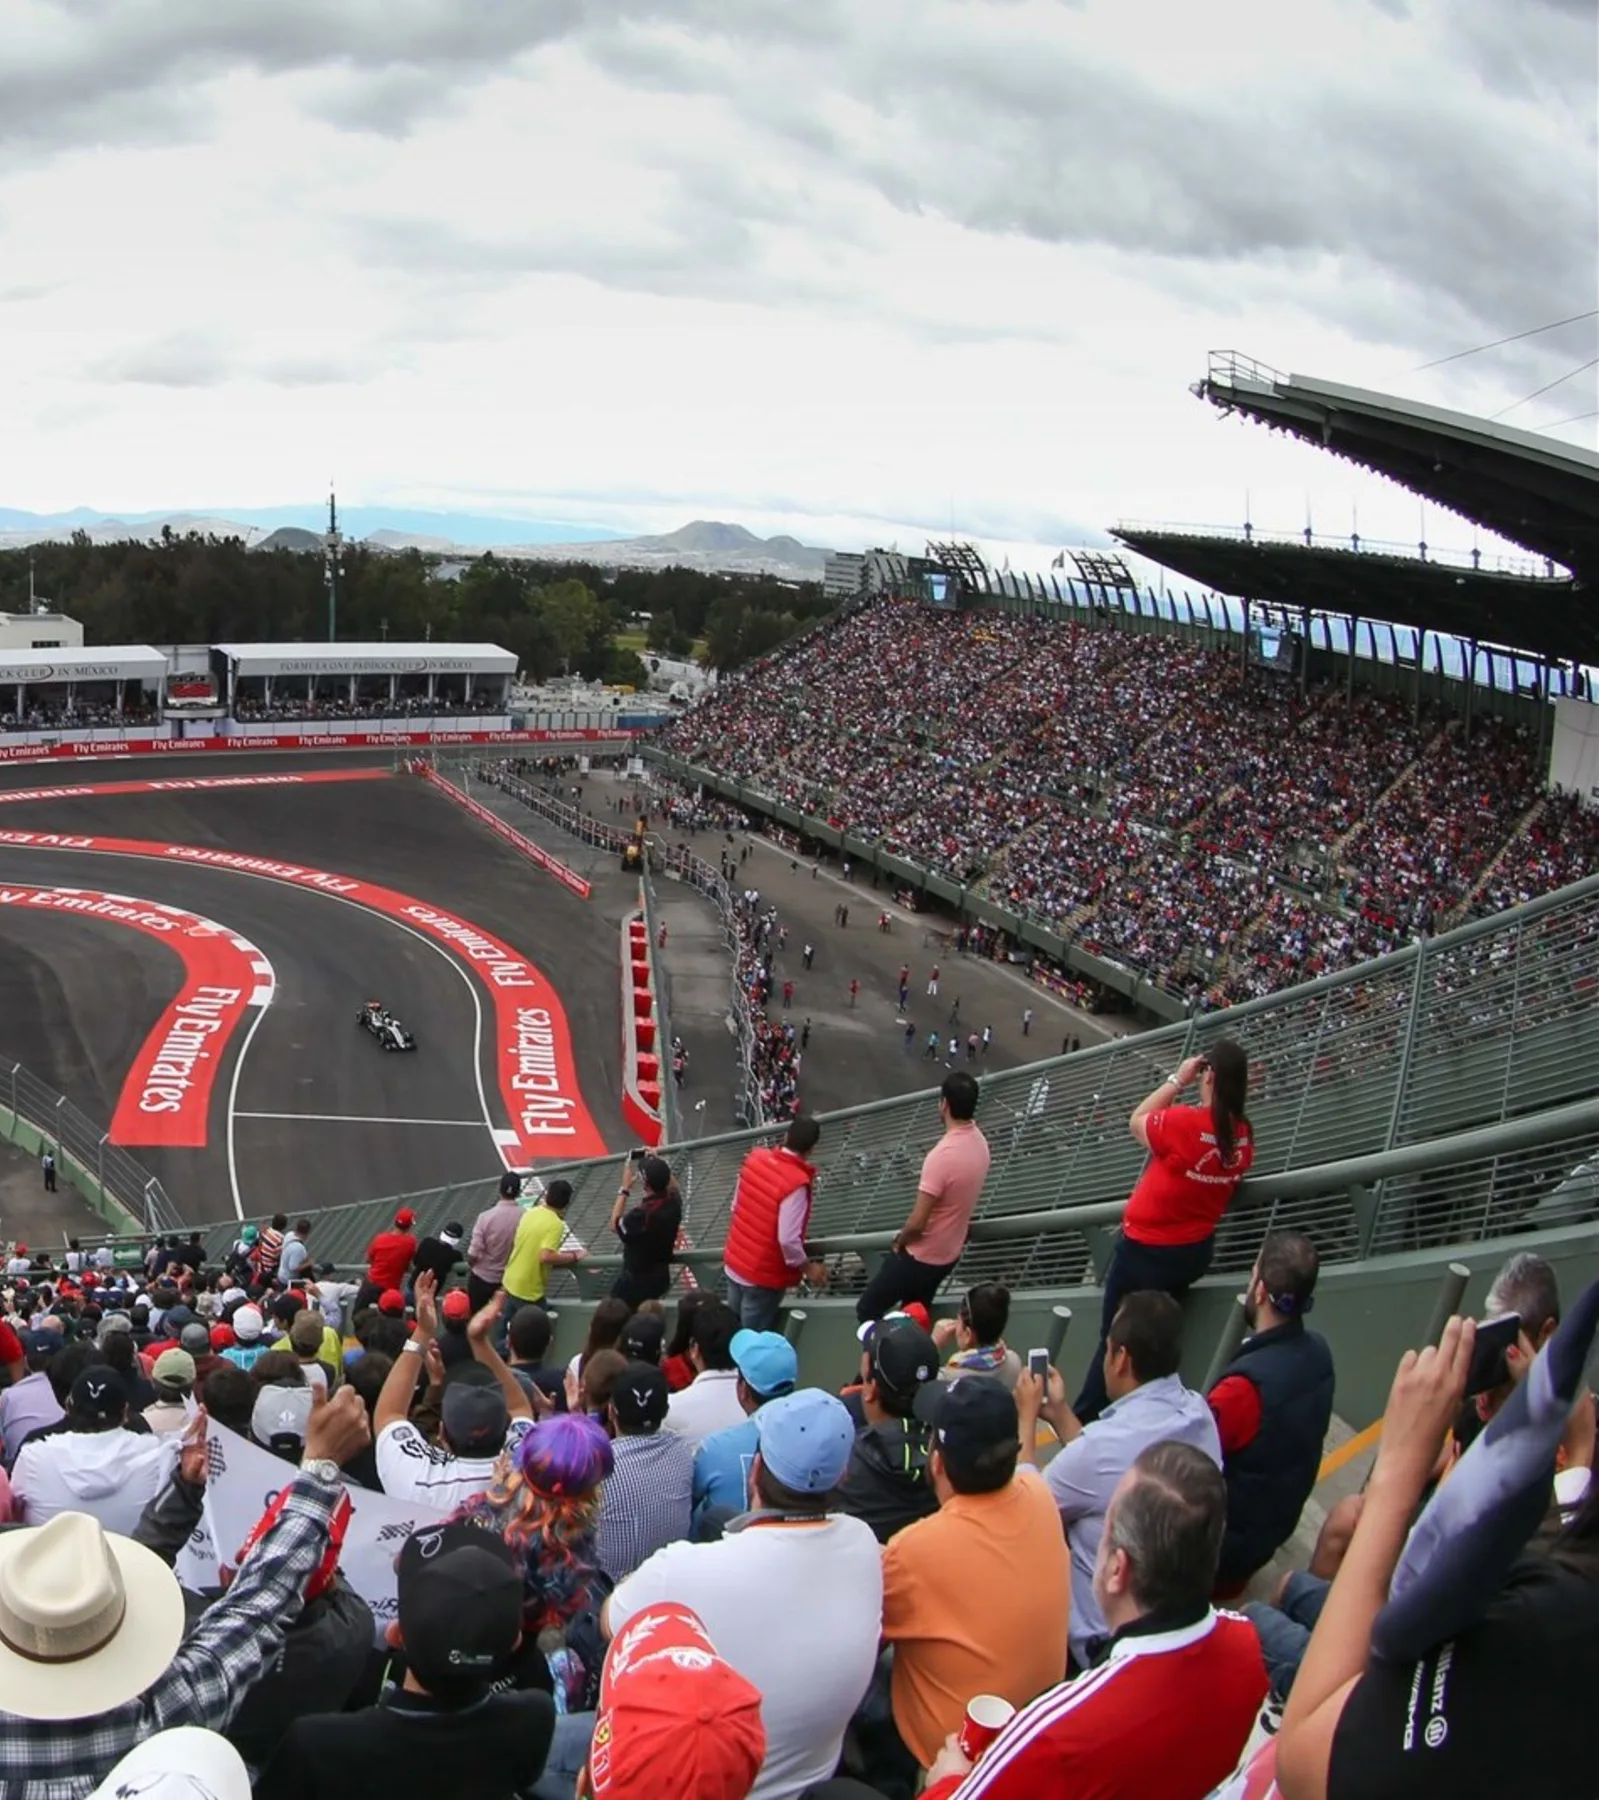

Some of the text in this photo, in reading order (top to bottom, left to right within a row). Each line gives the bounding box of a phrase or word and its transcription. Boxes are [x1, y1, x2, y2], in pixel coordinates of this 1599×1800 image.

[16, 667, 46, 678] CLUB
[58, 667, 69, 676] IN
[152, 739, 206, 751] Fly Emirates
[228, 736, 278, 748] Fly Emirates
[299, 735, 312, 746] Fly
[9, 745, 50, 757] Emirates
[73, 741, 129, 754] Fly Emirates
[147, 780, 196, 790] Fly
[39, 836, 94, 848] Fly
[164, 846, 360, 893] Fly Emirates
[28, 891, 181, 932] Emirates
[400, 904, 536, 987] Fly Emirates
[139, 985, 242, 1113] Fly Emirates
[507, 1006, 576, 1135] Fly Emirates
